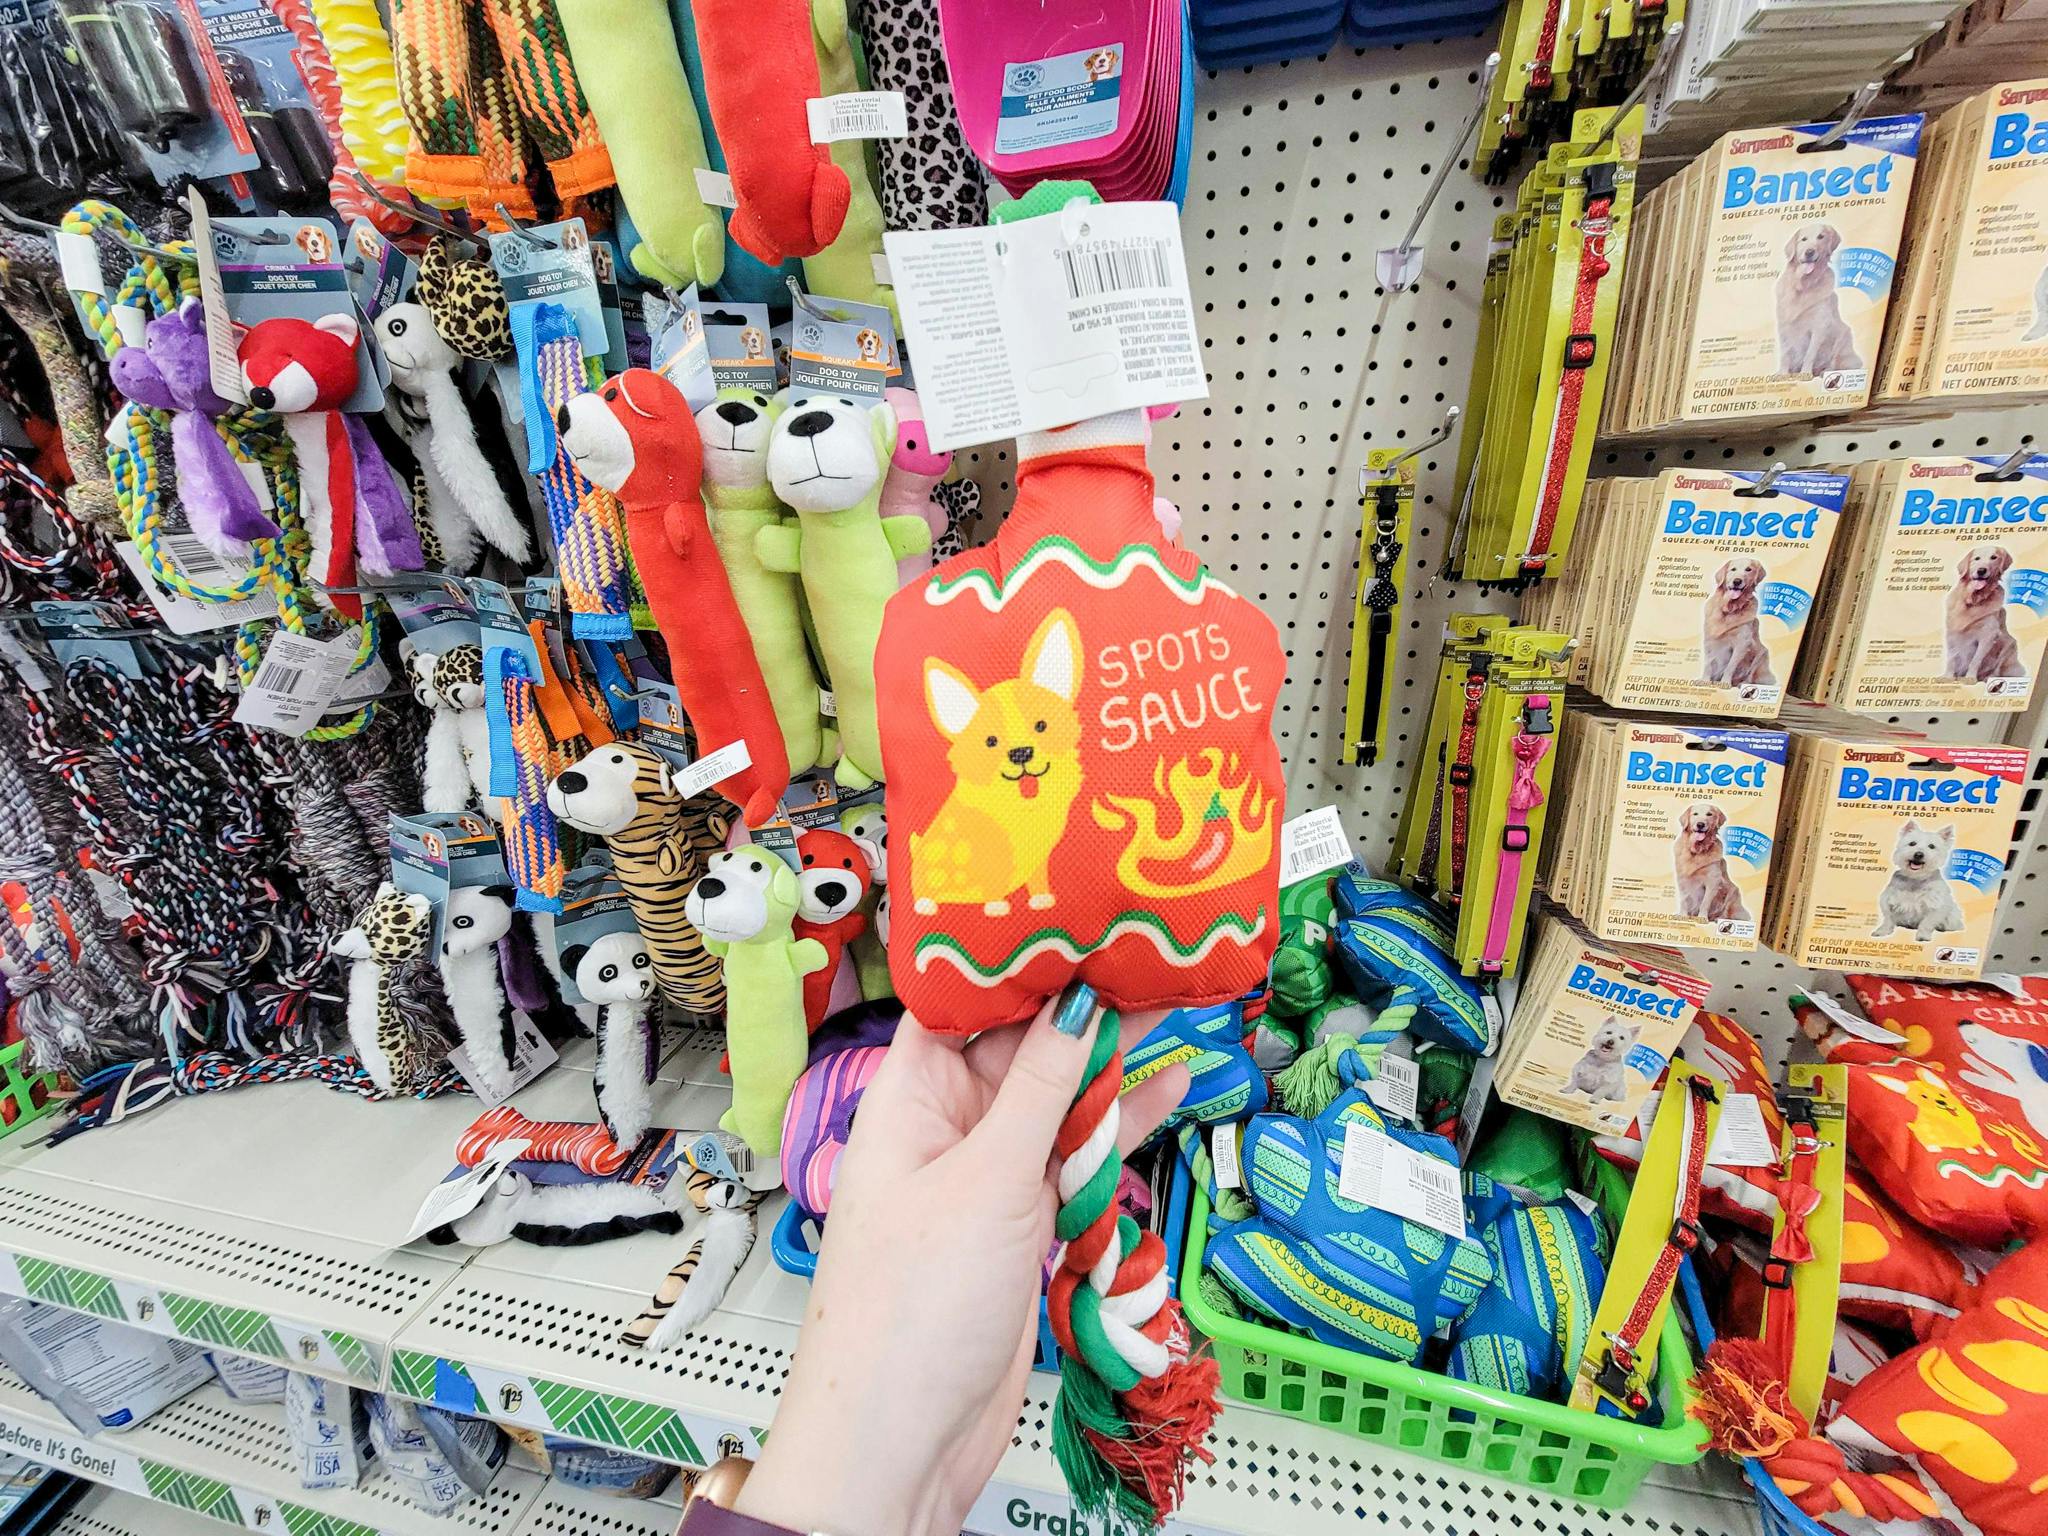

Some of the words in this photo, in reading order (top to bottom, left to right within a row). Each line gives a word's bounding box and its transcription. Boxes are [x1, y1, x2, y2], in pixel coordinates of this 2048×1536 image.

[229, 11, 258, 22] WASTE
[232, 22, 261, 33] POCHE
[1044, 88, 1065, 96] FOOD
[1067, 83, 1093, 92] SCOOP
[1025, 100, 1048, 109] PELLE
[1057, 91, 1095, 102] ALIMENTS
[1031, 104, 1051, 114] POUR
[1053, 98, 1088, 109] ANIMAUX
[1723, 153, 1894, 210] Bansect
[1722, 208, 1781, 221] SQUEEZE-ON
[1784, 205, 1805, 213] FLEA
[1819, 202, 1840, 210] TICK
[1844, 197, 1886, 207] CONTROL
[1781, 213, 1799, 221] FOR
[1802, 211, 1826, 219] DOGS
[538, 274, 550, 283] DOG
[552, 272, 563, 281] TOY
[527, 285, 546, 296] JOUET
[547, 282, 562, 292] POUR
[564, 279, 579, 289] CHIEN
[822, 355, 857, 366] SQUEAKY
[819, 367, 839, 377] DOG
[840, 369, 858, 380] TOY
[1945, 361, 1993, 374] CAUTION
[712, 371, 731, 380] DOG
[733, 371, 749, 380] TOY
[747, 382, 772, 391] CHIEN
[796, 375, 825, 387] JOUET
[827, 378, 851, 390] POUR
[853, 382, 879, 393] CHIEN
[1941, 379, 1961, 390] NET
[1964, 376, 2021, 388] CONTENTS:
[1693, 388, 1734, 399] CAUTION
[1691, 403, 1709, 414] NET
[1710, 402, 1760, 413] CONTENTS:
[1899, 489, 2048, 526] Bansec
[1664, 500, 1821, 539] Bansect
[1897, 528, 1955, 536] SQUEEZE-ON
[1662, 537, 1715, 545] SQUEEZE-ON
[1658, 564, 1690, 572] application
[1656, 572, 1682, 580] effective
[1689, 591, 1710, 600] quickly
[1658, 677, 1666, 685] OF
[1668, 678, 1688, 686] REACH
[1624, 683, 1661, 694] CAUTION
[1858, 685, 1899, 694] CAUTION
[1621, 695, 1637, 704] NET
[1639, 697, 1683, 707] CONTENTS:
[1684, 700, 1698, 709] One
[1855, 699, 1878, 707] NET
[1880, 699, 1924, 707] CONTENTS:
[1099, 666, 1263, 752] SAUCE
[652, 729, 662, 737] DOG
[662, 732, 672, 740] TOY
[657, 737, 669, 747] POUR
[1626, 751, 1768, 788] Bansect
[1627, 784, 1675, 792] SQUEEZE-ON
[1838, 767, 2002, 805] Bansect
[1837, 802, 1893, 810] SQUEEZE-ON
[805, 811, 818, 819] TOY
[816, 814, 835, 825] CHIEN
[762, 831, 772, 839] DOG
[1607, 916, 1643, 926] CAUTION
[1606, 928, 1622, 936] NET
[1624, 929, 1665, 940] CONTENTS:
[1808, 945, 1849, 955] CAUTION
[1810, 937, 1827, 946] KEEP
[1829, 938, 1843, 946] OUT
[1845, 939, 1854, 947] OF
[1854, 940, 1877, 949] REACH
[1888, 942, 1924, 952] CHILDREN
[1806, 956, 1824, 964] NET
[1825, 957, 1873, 968] CONTENTS:
[1567, 963, 1688, 1020] Bansect
[1602, 1005, 1616, 1014] FOR
[1617, 1009, 1634, 1019] DOGS
[1606, 1000, 1621, 1010] FLEA
[1630, 1007, 1644, 1016] TICK
[1646, 1013, 1675, 1026] CONTROL
[0, 1422, 42, 1452] Before
[46, 1439, 66, 1460] It's
[71, 1447, 116, 1476] Gone!
[315, 1459, 341, 1476] USA
[432, 1483, 462, 1501] USA
[1006, 1498, 1089, 1536] Grab
